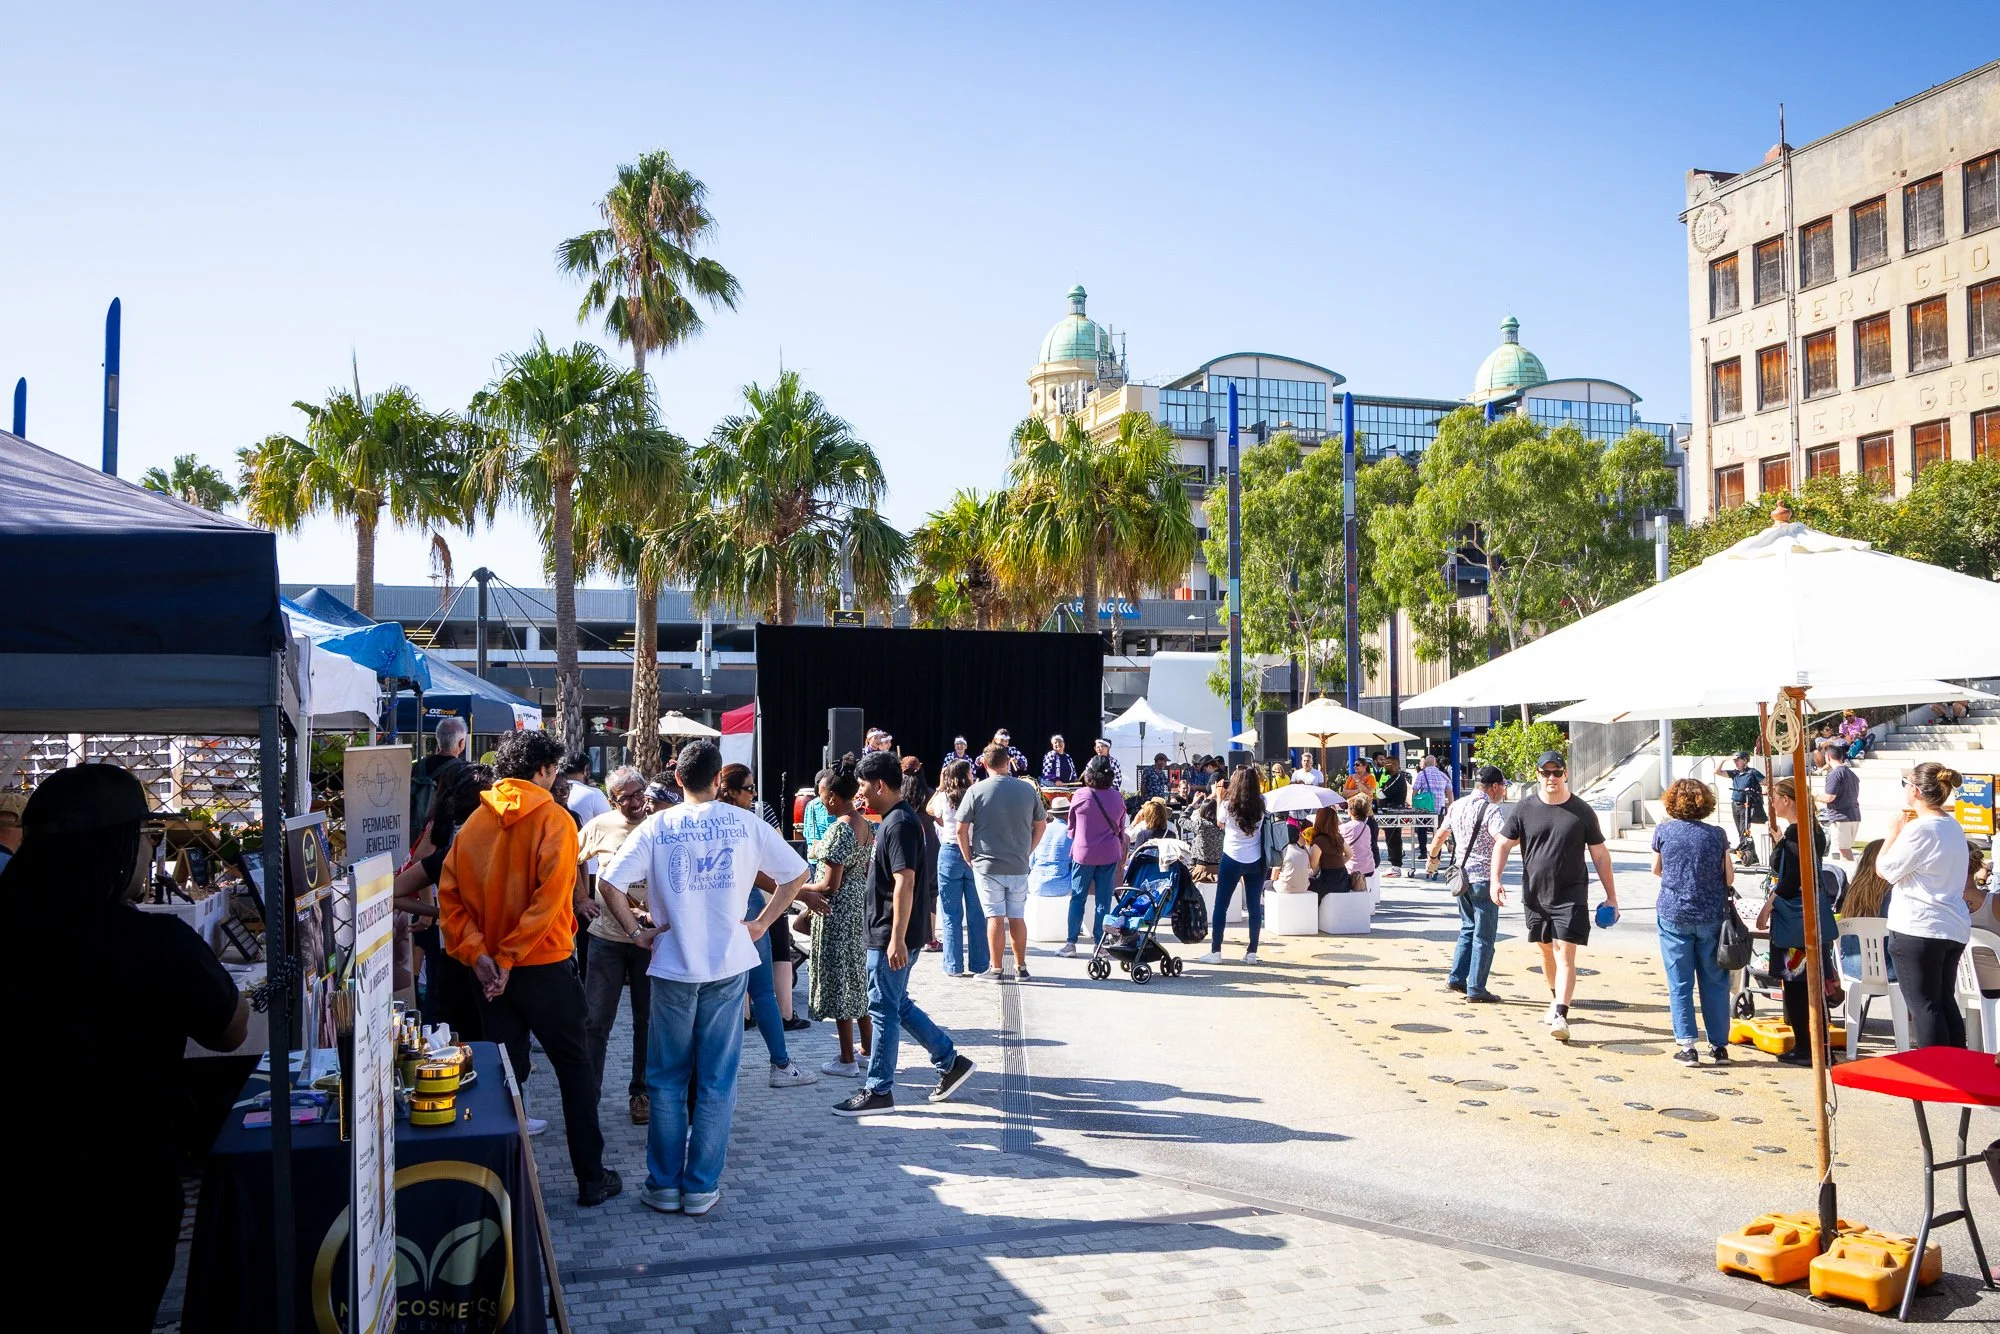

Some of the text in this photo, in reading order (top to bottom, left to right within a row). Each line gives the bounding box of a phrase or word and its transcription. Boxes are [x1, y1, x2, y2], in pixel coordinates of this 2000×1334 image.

[362, 814, 401, 833] PERMANENT
[709, 812, 740, 826] well-
[365, 834, 401, 854] JEWELLERY
[655, 824, 749, 845] deserved break
[688, 883, 696, 891] to
[697, 881, 707, 891] do
[694, 871, 734, 883] Feels Good
[396, 1297, 497, 1319] COSMECS
